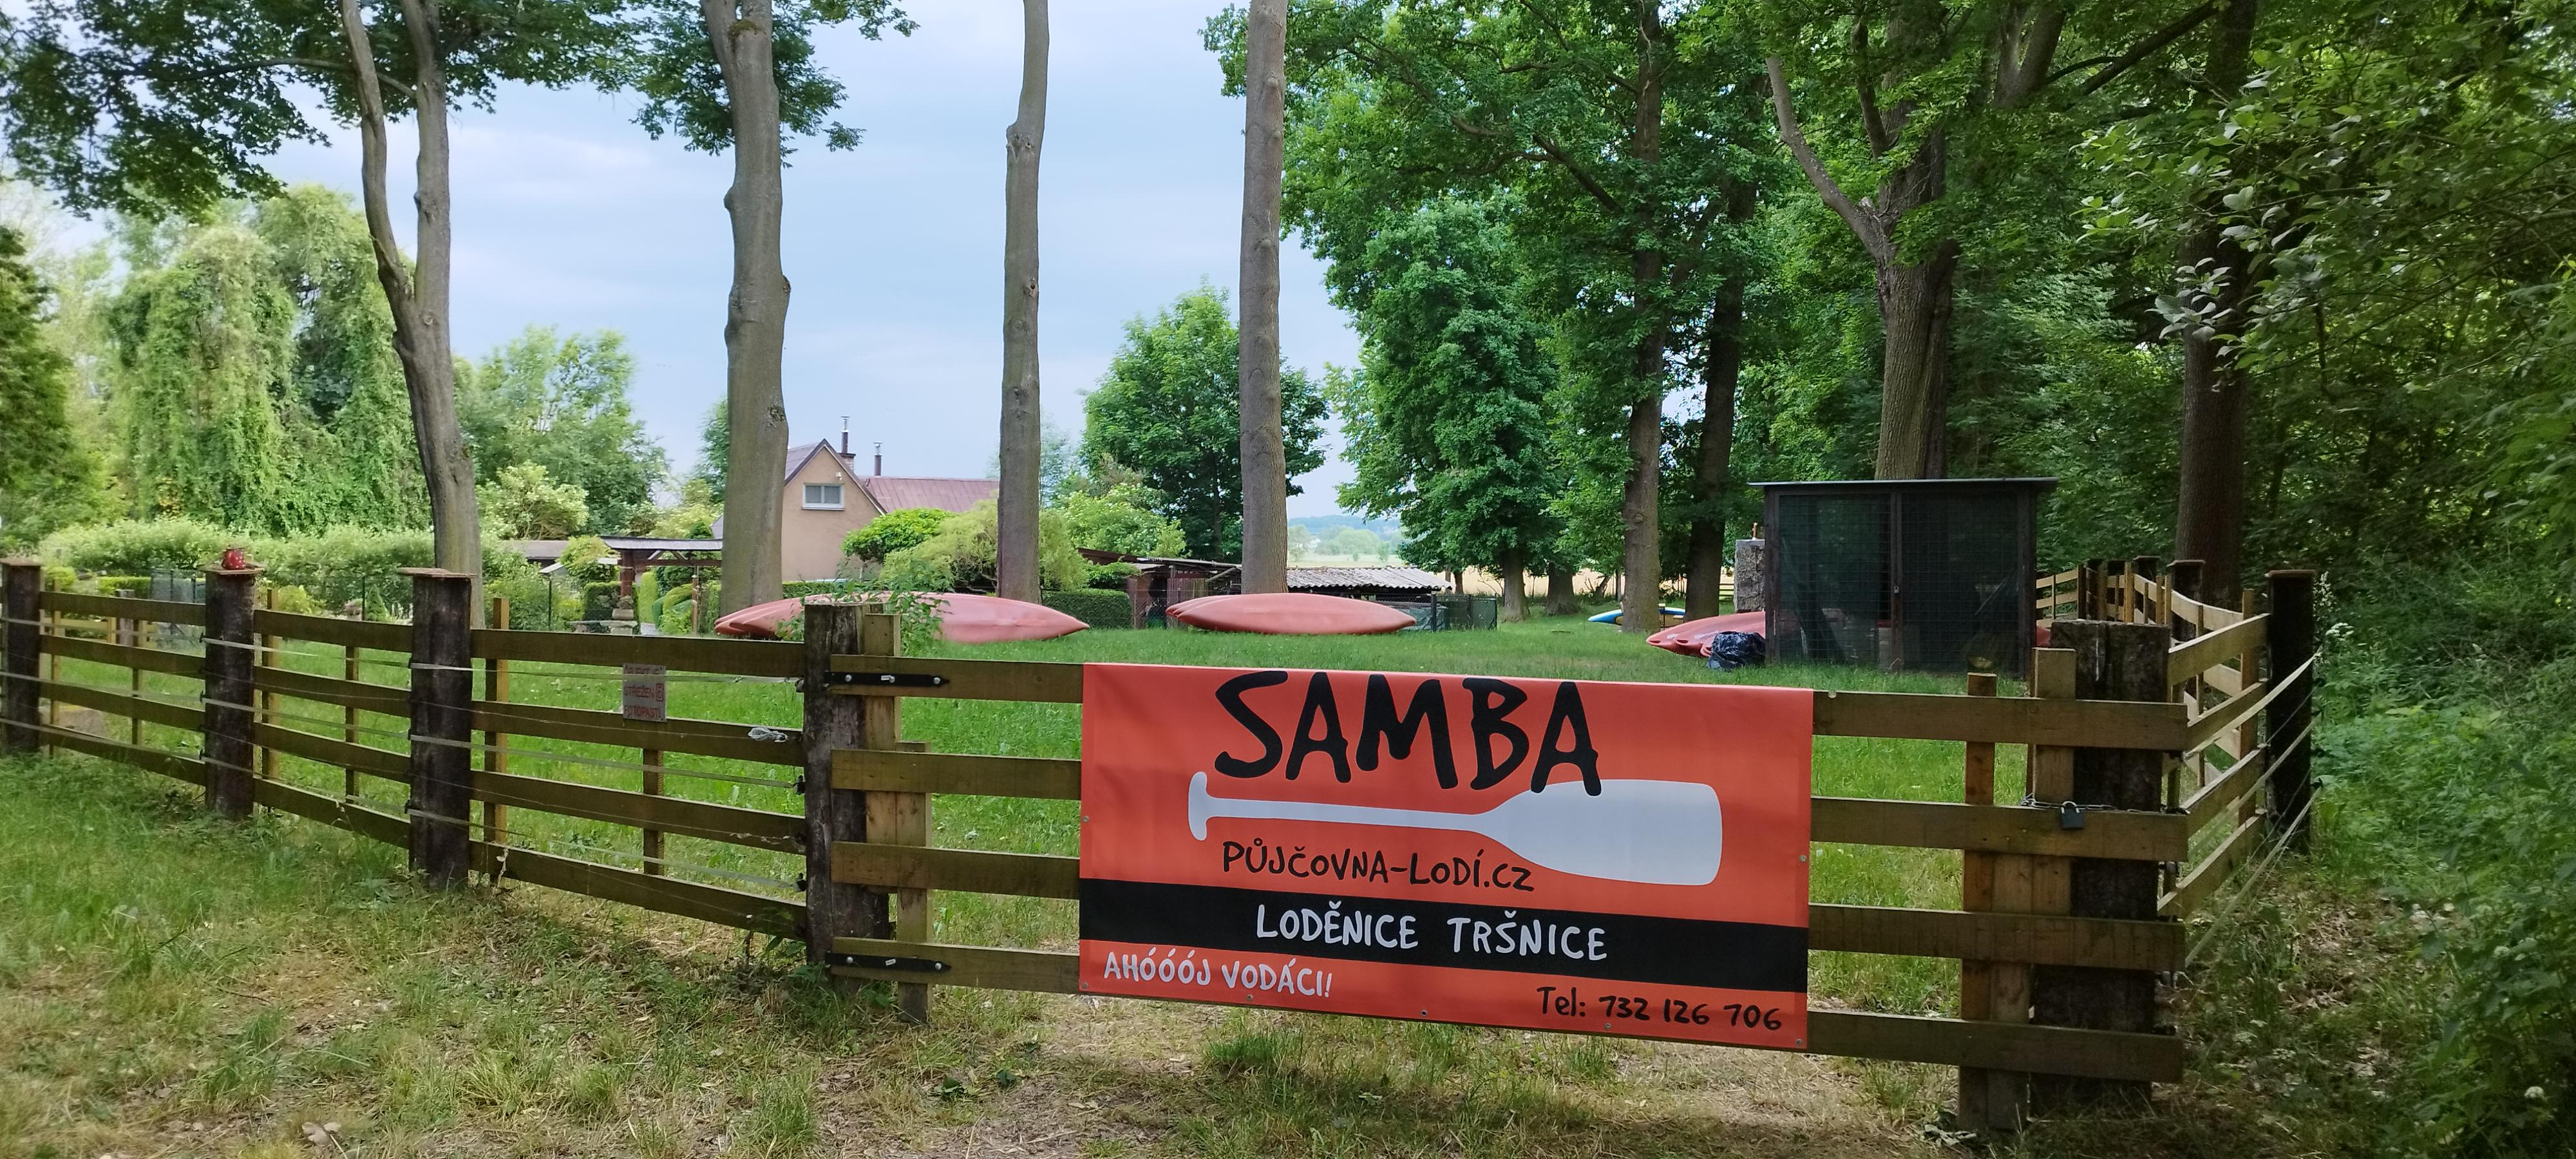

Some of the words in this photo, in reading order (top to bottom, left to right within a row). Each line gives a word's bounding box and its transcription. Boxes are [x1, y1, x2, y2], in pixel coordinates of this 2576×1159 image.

[1214, 670, 1602, 796] SAMBA
[1222, 837, 1535, 892] PŮJČOVNA-LODÍ.CZ
[1256, 900, 1419, 950] LODĚNICE
[1446, 909, 1608, 961] TRŠNICE
[1103, 947, 1211, 986] AHÓÓÓJ
[1220, 957, 1333, 998] VODÁCI!
[1536, 986, 1586, 1017] Tel:
[1598, 995, 1651, 1021] 732
[1662, 998, 1710, 1026] 126
[1723, 1003, 1783, 1031] 706
